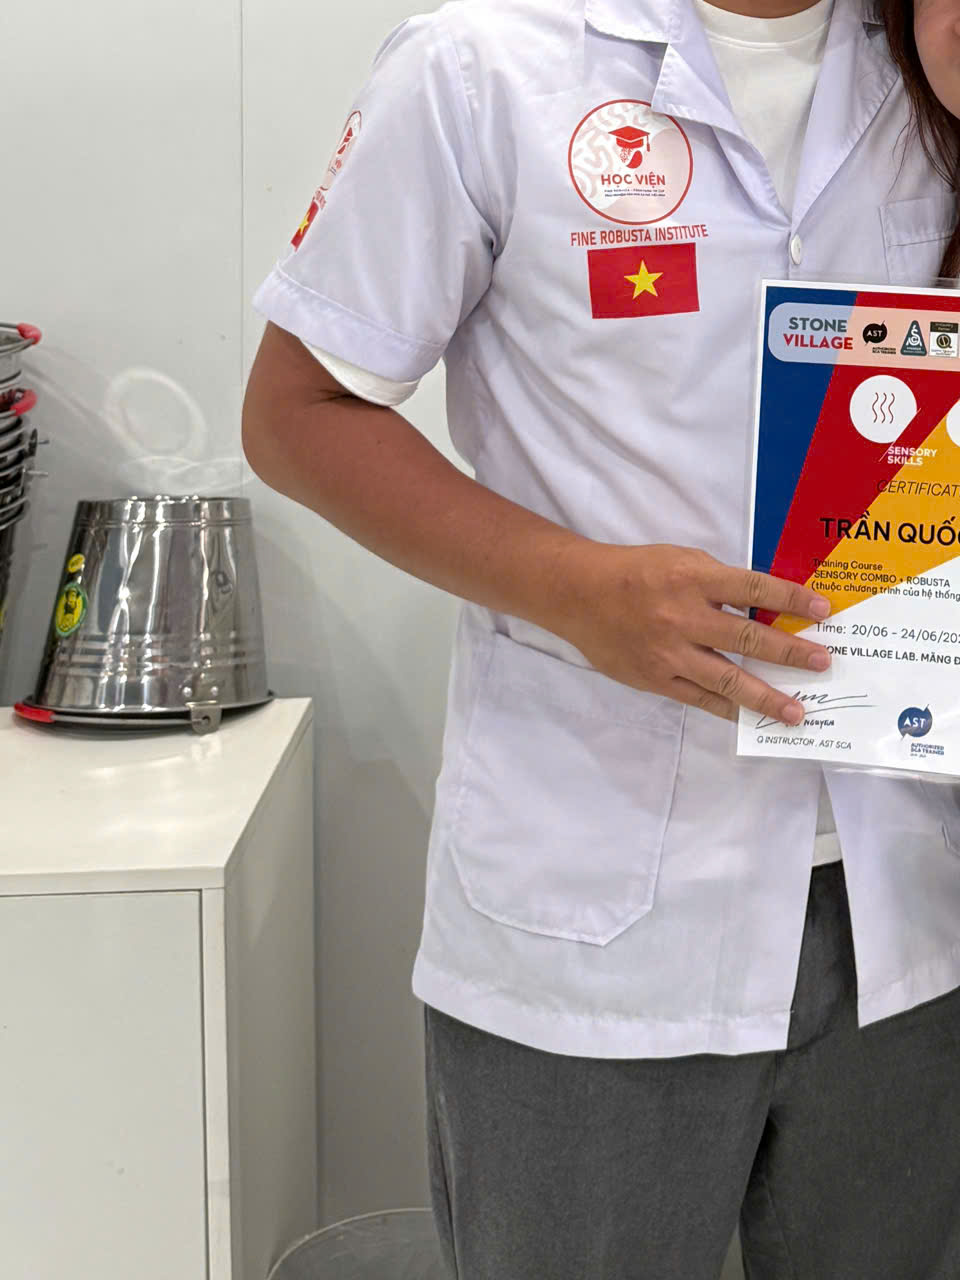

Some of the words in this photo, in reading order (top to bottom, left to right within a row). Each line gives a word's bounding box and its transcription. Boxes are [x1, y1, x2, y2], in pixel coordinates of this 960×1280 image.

[601, 174, 632, 188] HỌC
[635, 171, 666, 188] VIỆN
[571, 231, 597, 246] FINE
[600, 228, 652, 244] ROBUSTA
[655, 224, 709, 242] INSTITUTE
[789, 317, 847, 333] STONE
[783, 334, 853, 350] VILLAGE
[888, 446, 937, 457] SENSORY
[887, 455, 923, 465] SKILLS
[820, 510, 890, 542] TRẦN
[813, 558, 849, 570] Training
[851, 560, 883, 571] Course
[814, 570, 858, 581] SENSORY
[860, 572, 897, 583] COMBO
[906, 576, 950, 587] ROBUSTA
[811, 581, 842, 593] (thuộc
[844, 583, 878, 595] chương
[880, 584, 900, 597] trình
[903, 587, 920, 598] của
[922, 589, 933, 600] hệ
[816, 622, 846, 634] Time:
[852, 624, 888, 638] 20/06
[824, 645, 848, 655] ONE
[850, 647, 893, 659] VILLAGE
[895, 651, 918, 661] LAB.
[903, 717, 926, 728] AST
[757, 736, 763, 744] Q
[765, 737, 814, 747] INSTRUCTOR
[819, 740, 835, 748] AST
[836, 741, 852, 749] SCA
